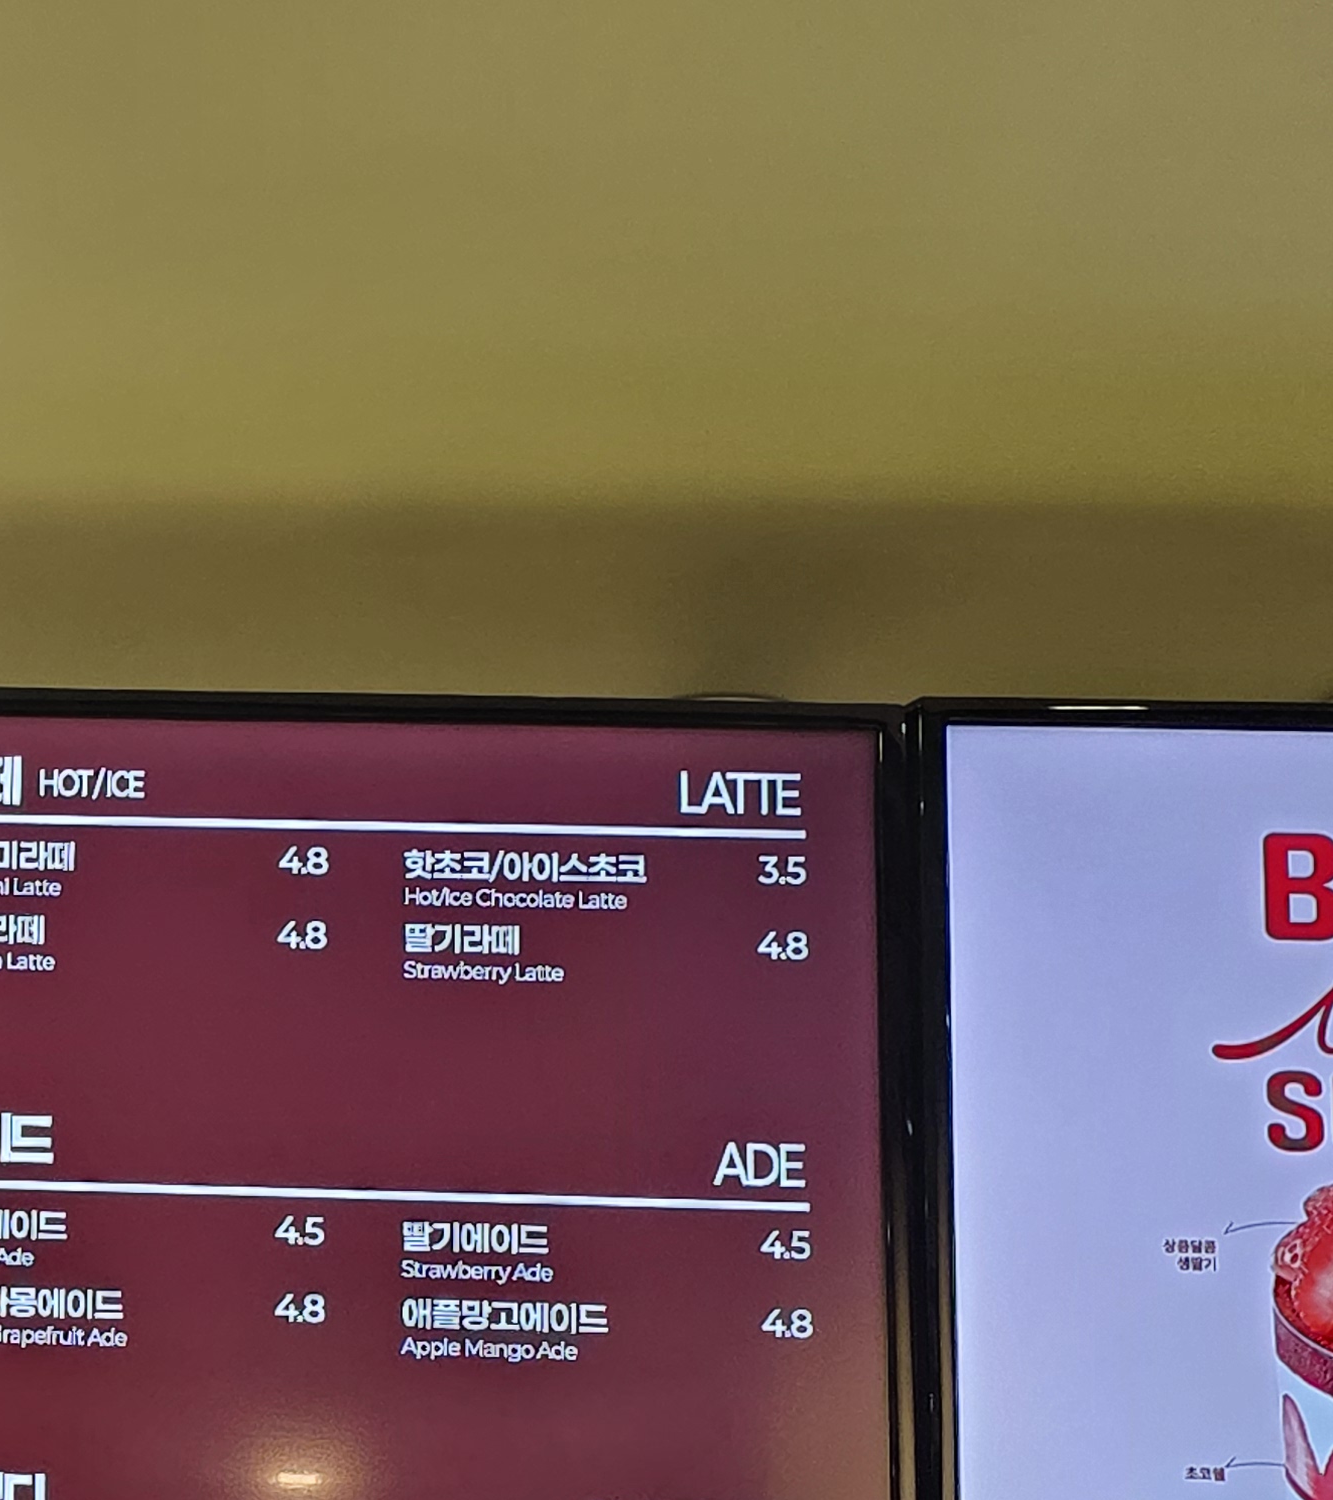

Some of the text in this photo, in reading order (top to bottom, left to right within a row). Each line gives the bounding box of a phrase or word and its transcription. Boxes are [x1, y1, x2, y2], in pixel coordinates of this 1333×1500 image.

[38, 766, 145, 800] HOT/ICE
[679, 770, 801, 816] LATTE
[278, 845, 329, 875] 4.8
[403, 848, 647, 883] 핫초코/아이스초코
[757, 855, 806, 885] 3.5
[404, 922, 520, 956] 딸기라떼
[6, 951, 56, 971] Latte
[403, 960, 564, 985] Strawberry Latte
[712, 1141, 806, 1188] ADE
[274, 1215, 325, 1246] 4.5
[402, 1220, 549, 1255] 딸기에이드
[759, 1229, 811, 1260] 4.5
[401, 1297, 609, 1335] 애플망고에이드
